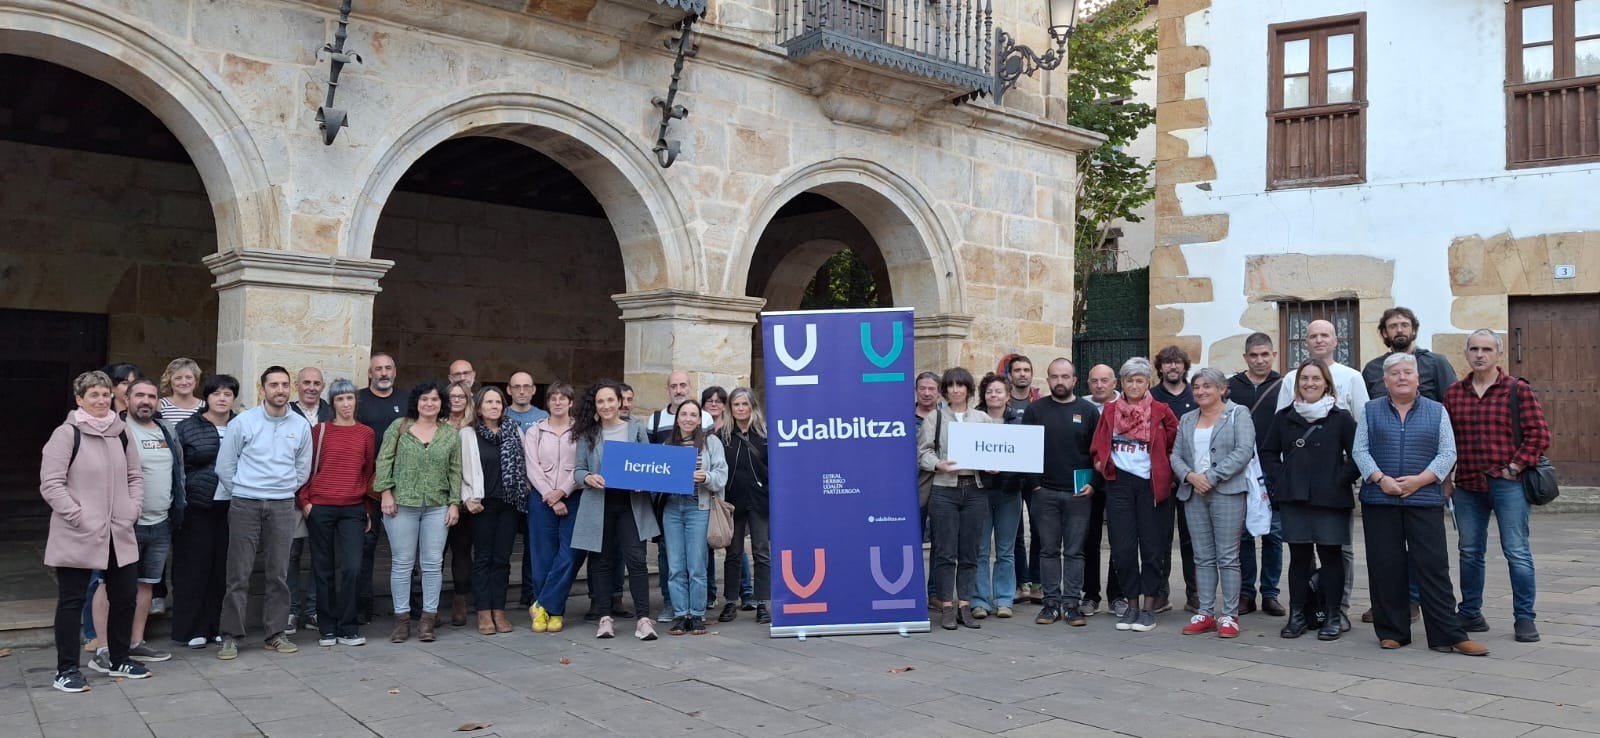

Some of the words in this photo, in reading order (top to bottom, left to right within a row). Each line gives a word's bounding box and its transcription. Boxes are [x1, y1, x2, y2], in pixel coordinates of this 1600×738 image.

[777, 417, 906, 447] Udalbiltza
[975, 440, 1015, 454] Herria
[624, 459, 671, 475] herriek
